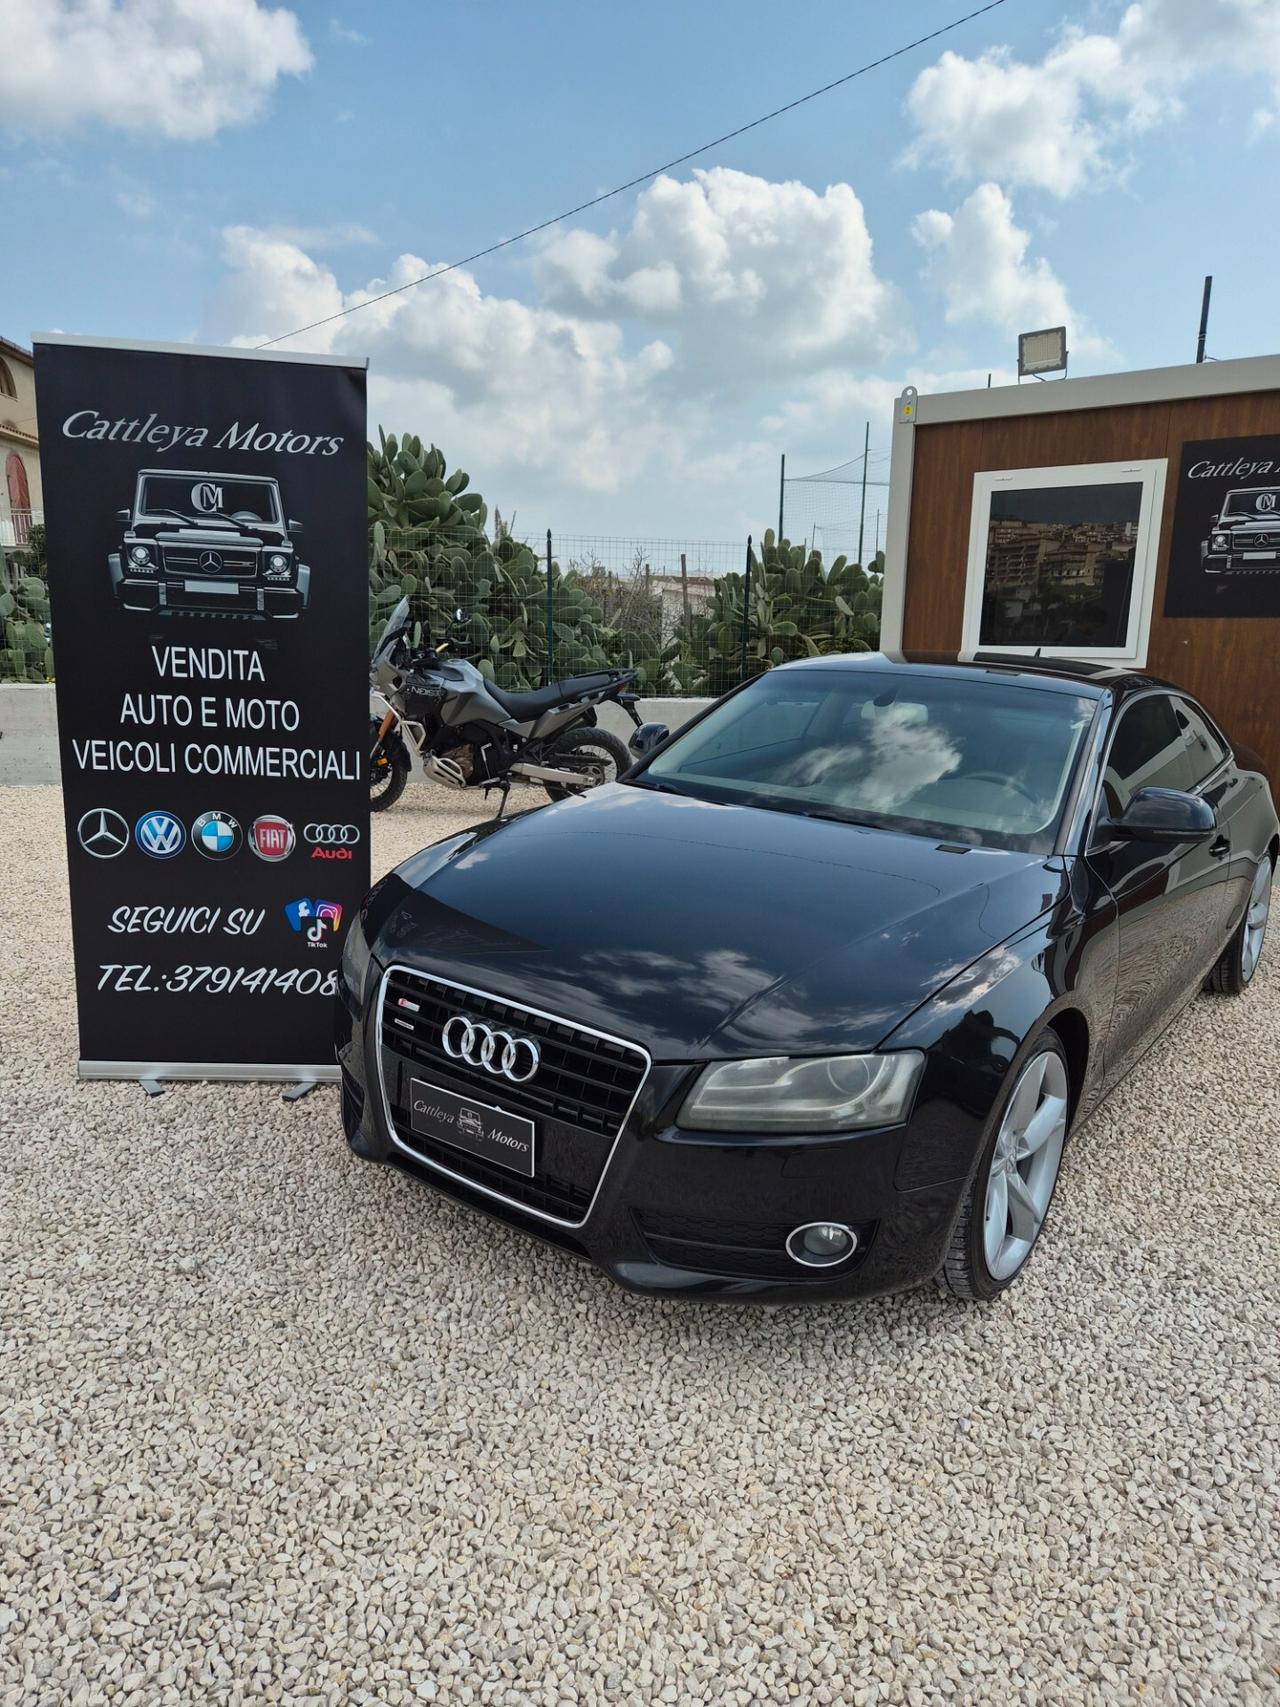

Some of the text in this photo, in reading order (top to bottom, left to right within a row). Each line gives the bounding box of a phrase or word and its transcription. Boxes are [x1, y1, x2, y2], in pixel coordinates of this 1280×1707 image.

[62, 410, 344, 456] Cattleya Motors
[1187, 457, 1274, 480] Cattleya
[151, 645, 266, 682] VENDITA
[120, 693, 300, 731] AUTO E MOTO
[72, 738, 361, 781] VEICOLI COMMERCIALI
[197, 813, 238, 828] BMW
[259, 828, 286, 849] FIAT
[311, 846, 353, 860] Audi
[107, 905, 266, 936] SEGUICI SU
[413, 1100, 455, 1124] Cattleya
[487, 1128, 529, 1153] Motors
